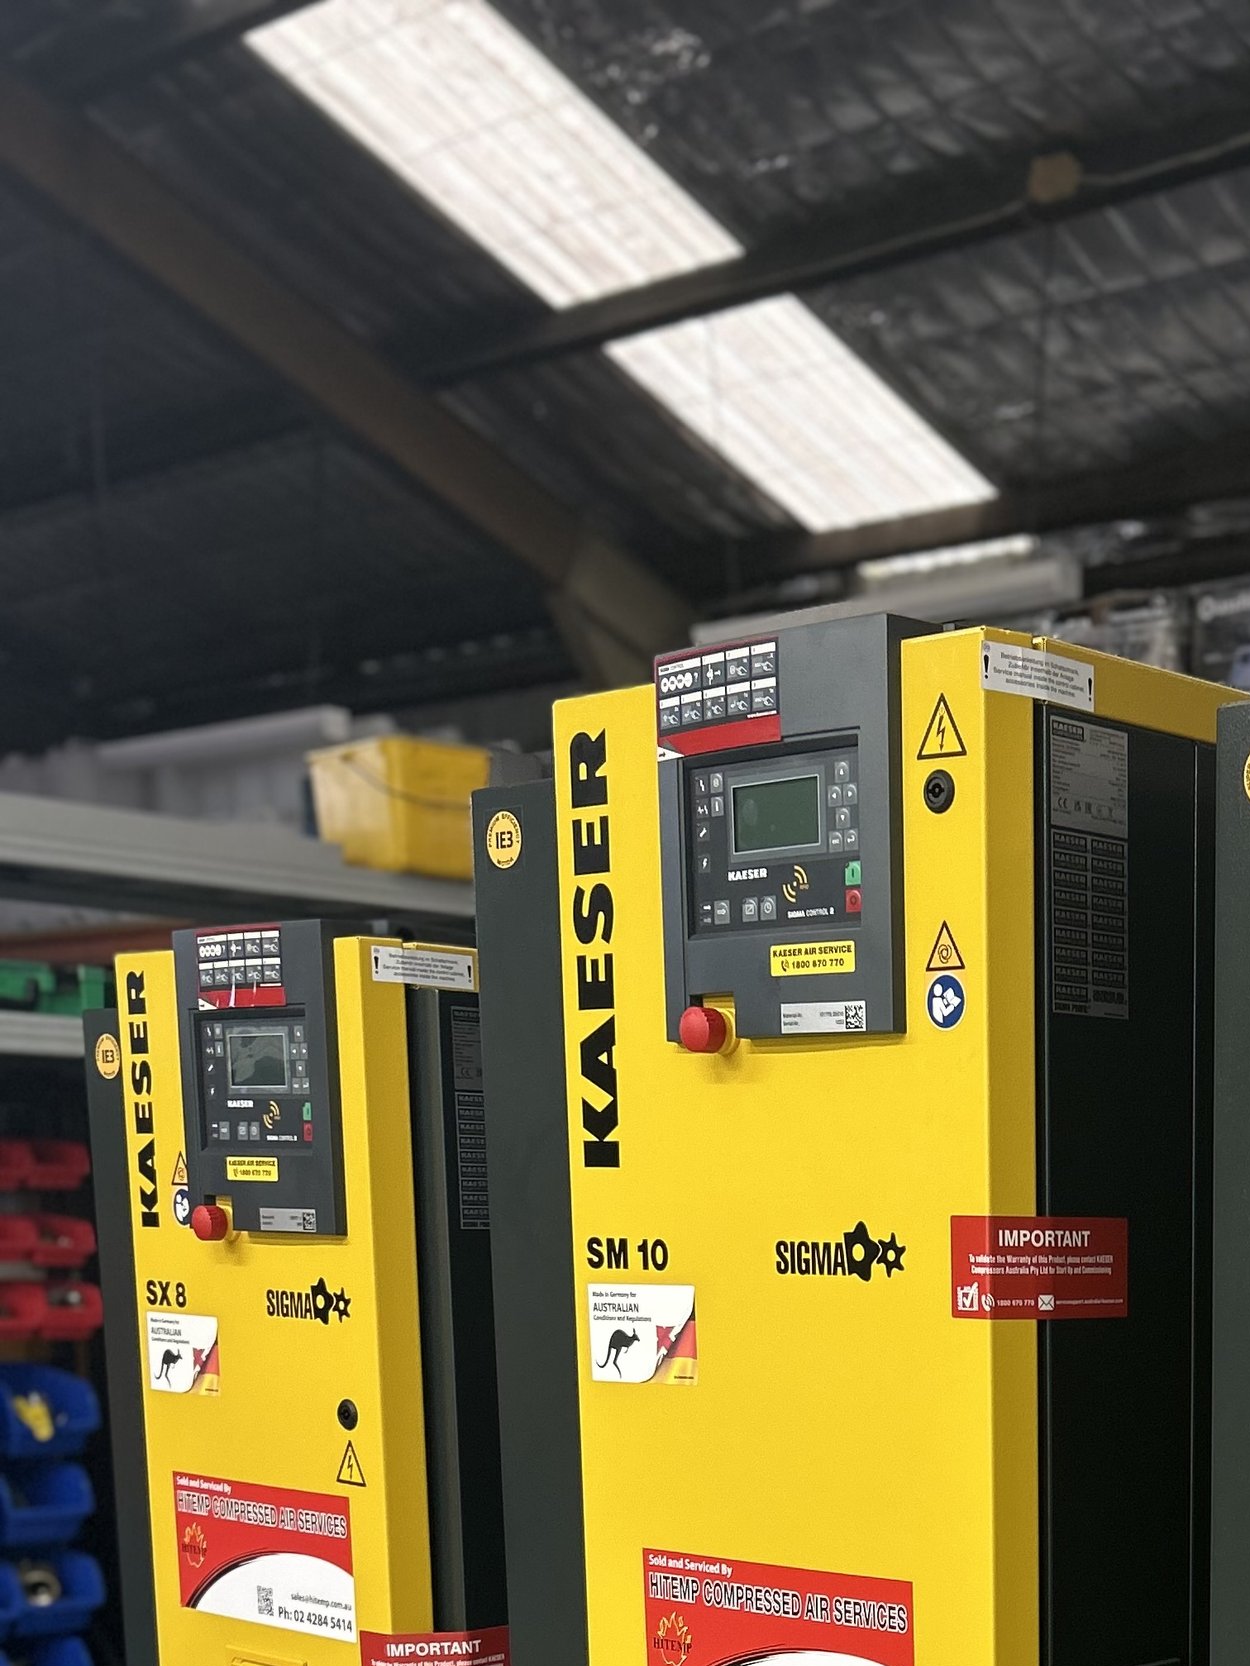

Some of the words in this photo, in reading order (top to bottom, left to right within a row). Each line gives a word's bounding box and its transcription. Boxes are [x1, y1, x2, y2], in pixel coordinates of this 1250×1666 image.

[496, 831, 513, 849] IE3
[728, 867, 768, 882] KAESER
[570, 727, 621, 1168] KAESER
[773, 948, 802, 958] KAESER
[804, 947, 817, 955] AIR
[818, 945, 852, 954] SERVICE
[792, 960, 810, 969] 1800
[829, 958, 845, 967] 770
[102, 1049, 115, 1064] IE3
[126, 970, 160, 1228] KAESER
[227, 1100, 254, 1108] KAESER
[998, 1229, 1090, 1247] IMPORTANT
[587, 1236, 629, 1270] SM
[638, 1239, 668, 1271] 10
[775, 1240, 845, 1276] SIGMA
[997, 1255, 1005, 1263] the
[1006, 1255, 1031, 1265] Warranty
[1038, 1254, 1047, 1263] this
[1005, 1265, 1029, 1275] Australia
[1030, 1266, 1039, 1276] Pty
[1040, 1266, 1048, 1274] Ltd
[147, 1279, 172, 1307] SX
[176, 1282, 187, 1308] 8
[266, 1289, 314, 1320] SIGMA
[593, 1302, 639, 1313] AUSTRALIAN
[177, 1476, 188, 1486] Sold
[189, 1478, 199, 1488] and
[200, 1479, 223, 1492] Serviced
[224, 1483, 232, 1495] By
[177, 1490, 211, 1516] HITEMP
[212, 1497, 277, 1527] COMPRESSED
[279, 1507, 296, 1530] AIR
[299, 1509, 347, 1539] SERVICES
[649, 1554, 667, 1567] Sold
[668, 1557, 683, 1569] and
[685, 1559, 720, 1575] Serviced
[721, 1565, 733, 1578] By
[291, 1593, 352, 1611] sales@hitemp.com.au
[648, 1571, 700, 1604] HITEMP
[703, 1579, 801, 1617] COMPRESSED
[804, 1594, 830, 1623] AIR
[833, 1597, 908, 1633] SERVICES
[278, 1606, 293, 1620] Ph:
[294, 1611, 304, 1623] 02
[307, 1612, 328, 1627] 4284
[330, 1617, 352, 1632] 5414
[387, 1639, 481, 1657] IMPORTANT
[653, 1636, 692, 1655] HITEMP
